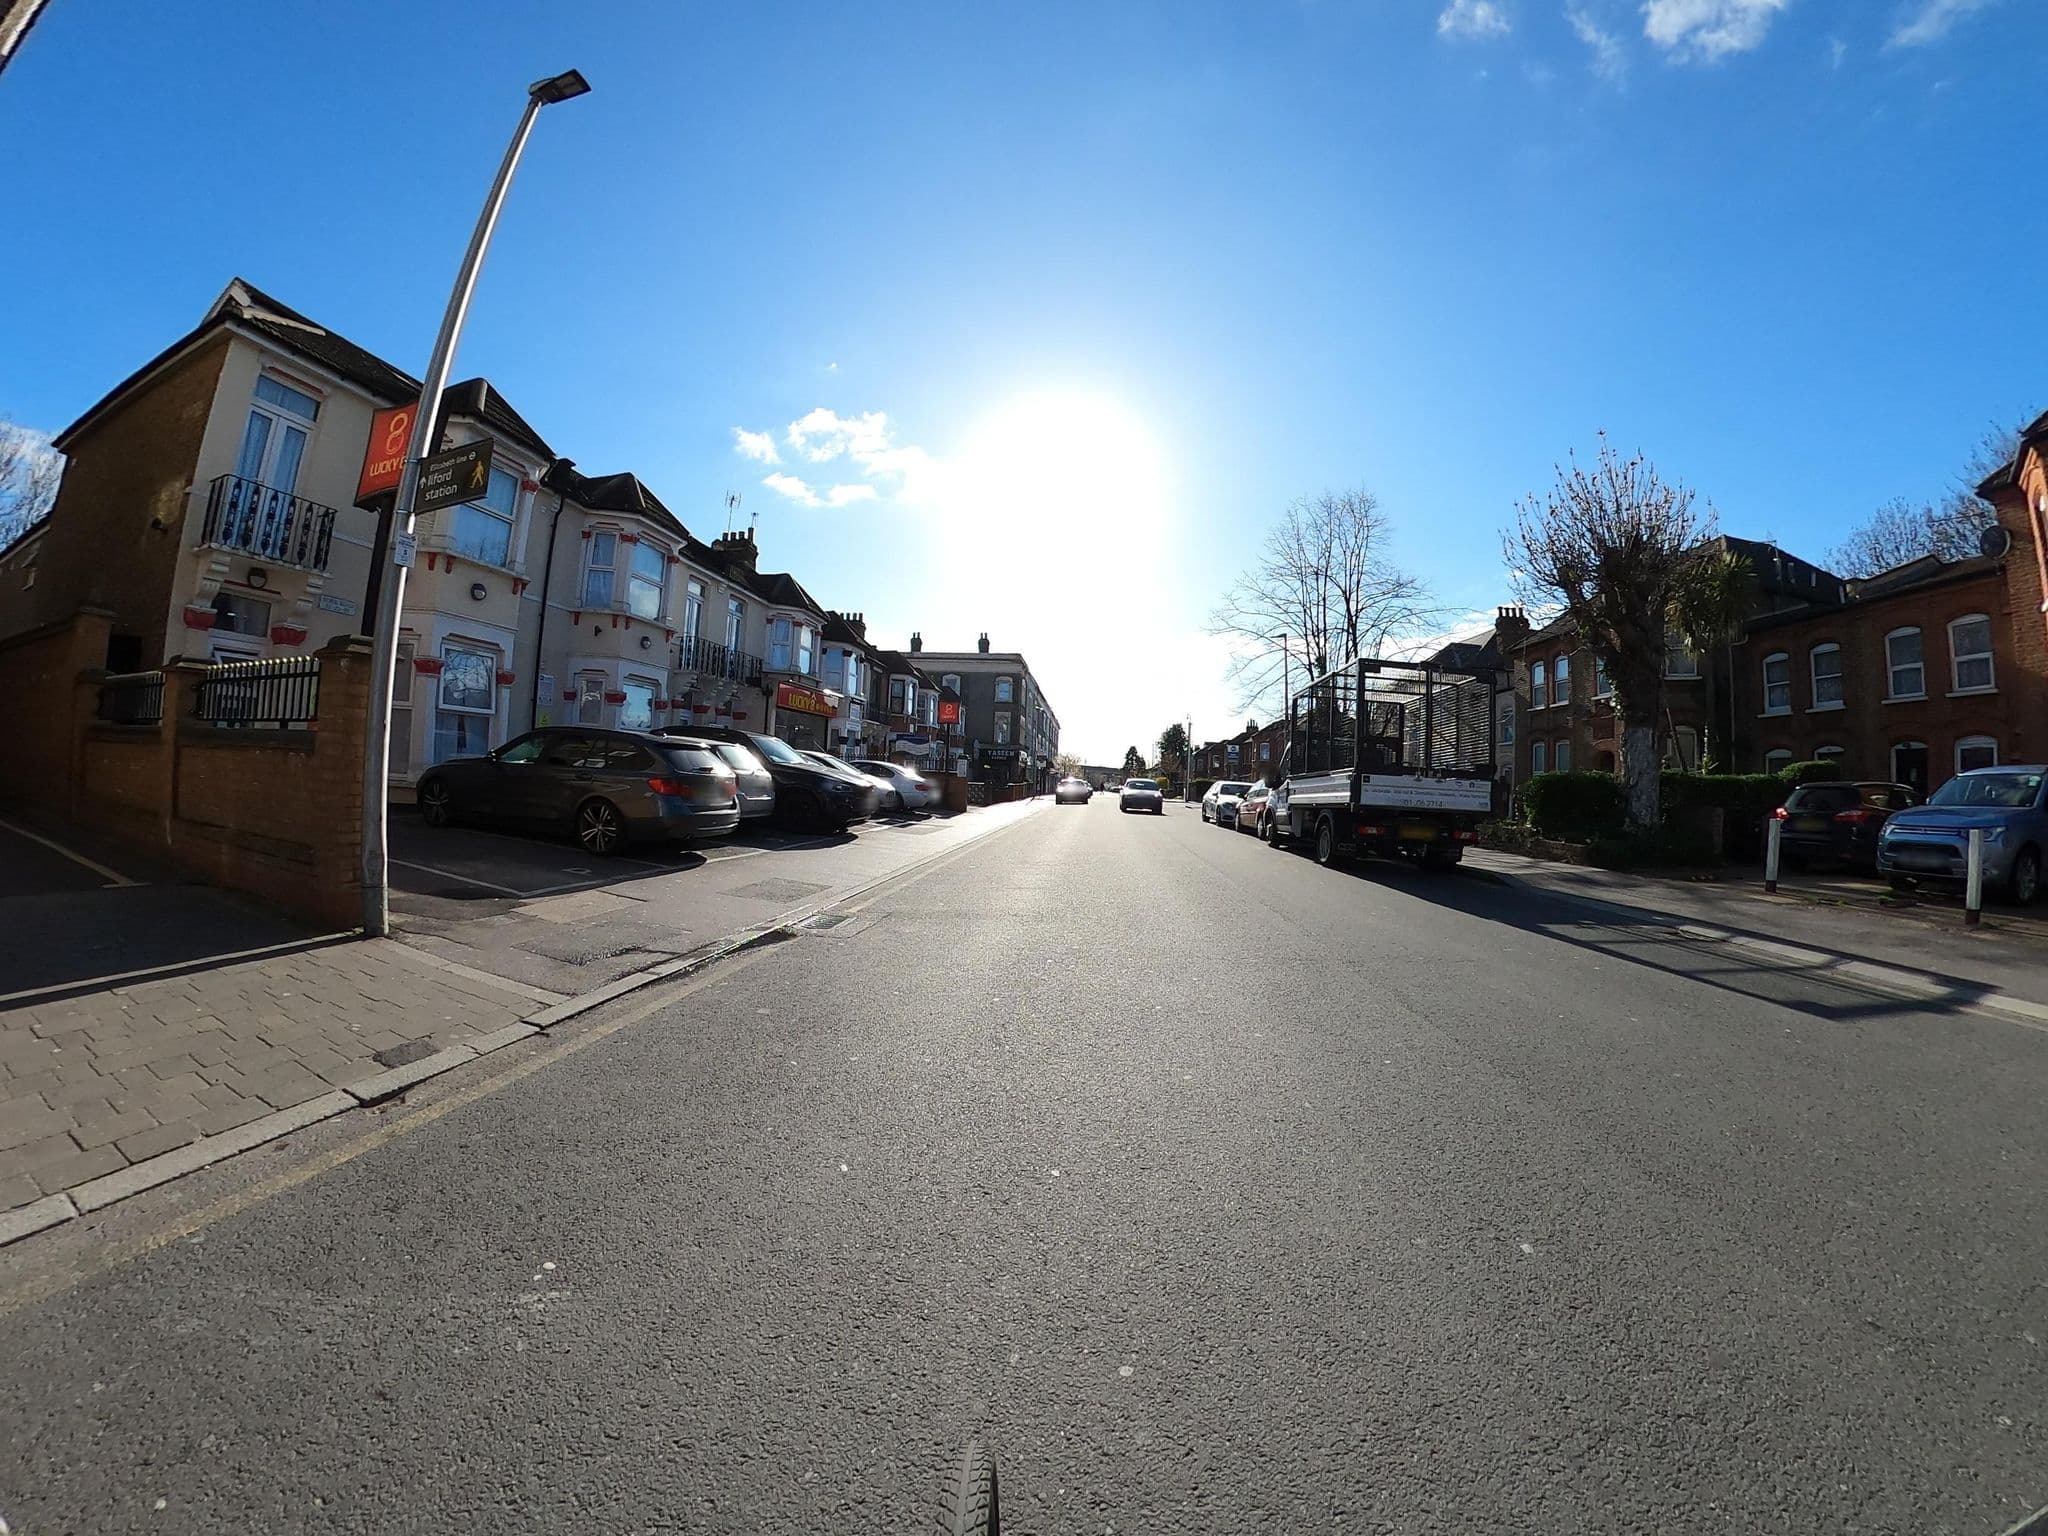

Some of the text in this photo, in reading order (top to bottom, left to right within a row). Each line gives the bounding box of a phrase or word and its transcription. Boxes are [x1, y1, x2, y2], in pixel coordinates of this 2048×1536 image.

[370, 458, 400, 476] LUCKY
[427, 469, 453, 486] Ilford
[425, 485, 457, 501] station
[789, 693, 810, 709] LUCKY
